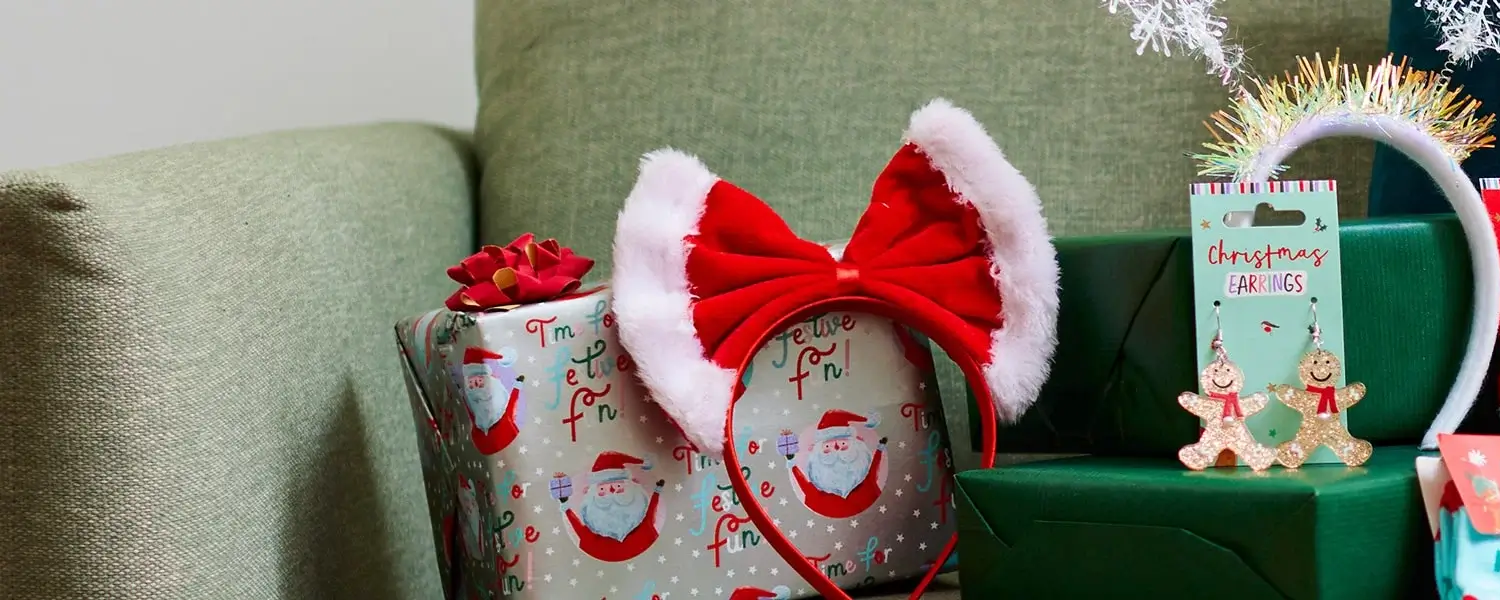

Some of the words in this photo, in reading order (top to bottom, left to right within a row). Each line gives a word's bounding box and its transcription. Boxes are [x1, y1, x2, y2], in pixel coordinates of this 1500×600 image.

[1208, 239, 1329, 269] Christmas
[1228, 273, 1304, 295] EARRINGS
[586, 299, 614, 334] fo
[857, 536, 892, 572] for
